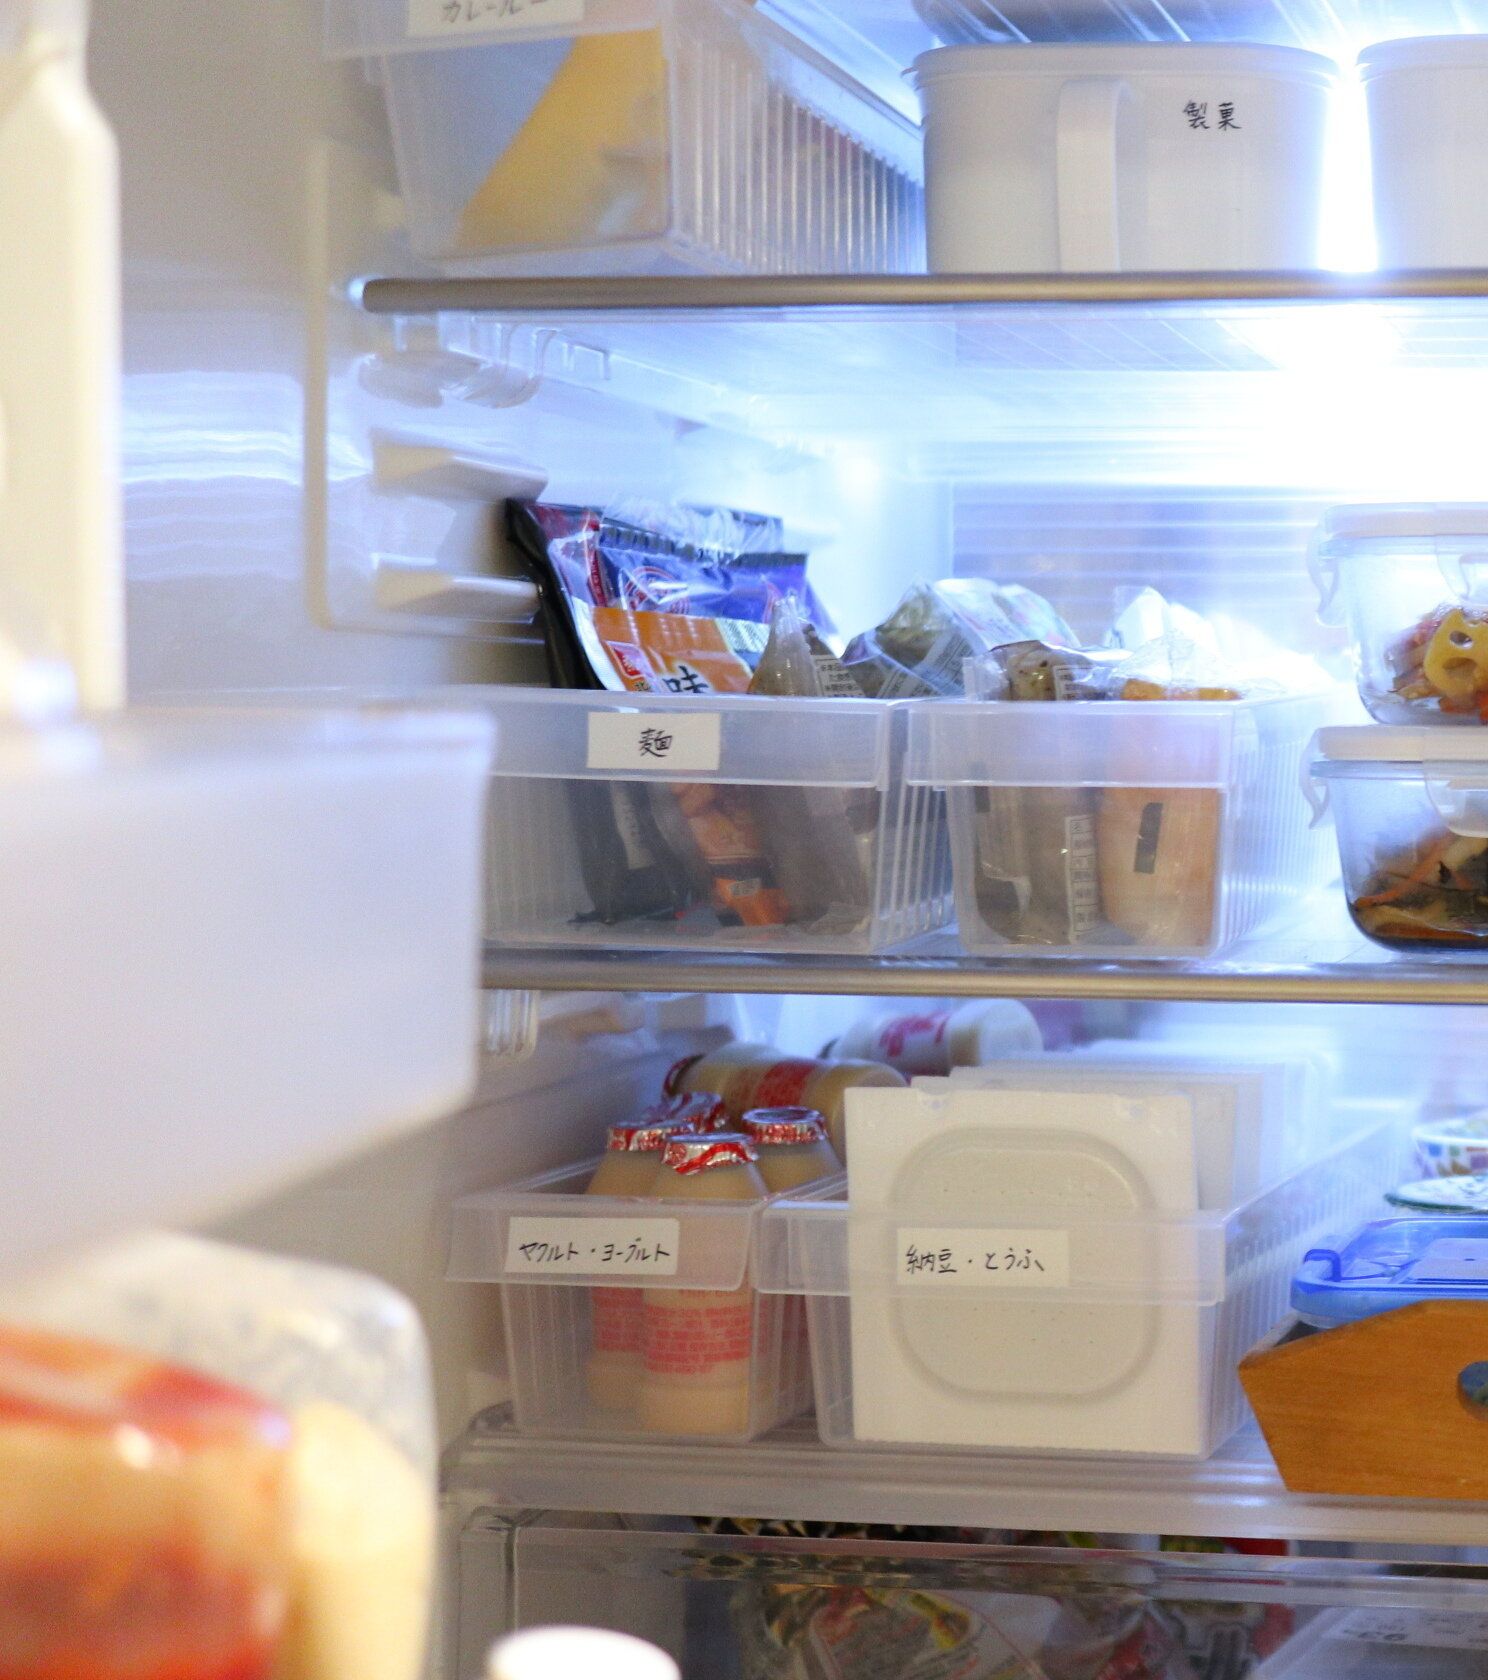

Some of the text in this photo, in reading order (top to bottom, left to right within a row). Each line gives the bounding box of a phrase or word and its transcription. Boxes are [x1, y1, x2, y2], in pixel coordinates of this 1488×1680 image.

[1183, 100, 1242, 131] 製菓
[519, 1237, 670, 1262] ヤクルト・ヨーグルト
[906, 1245, 1045, 1274] 納豆・とうふ
